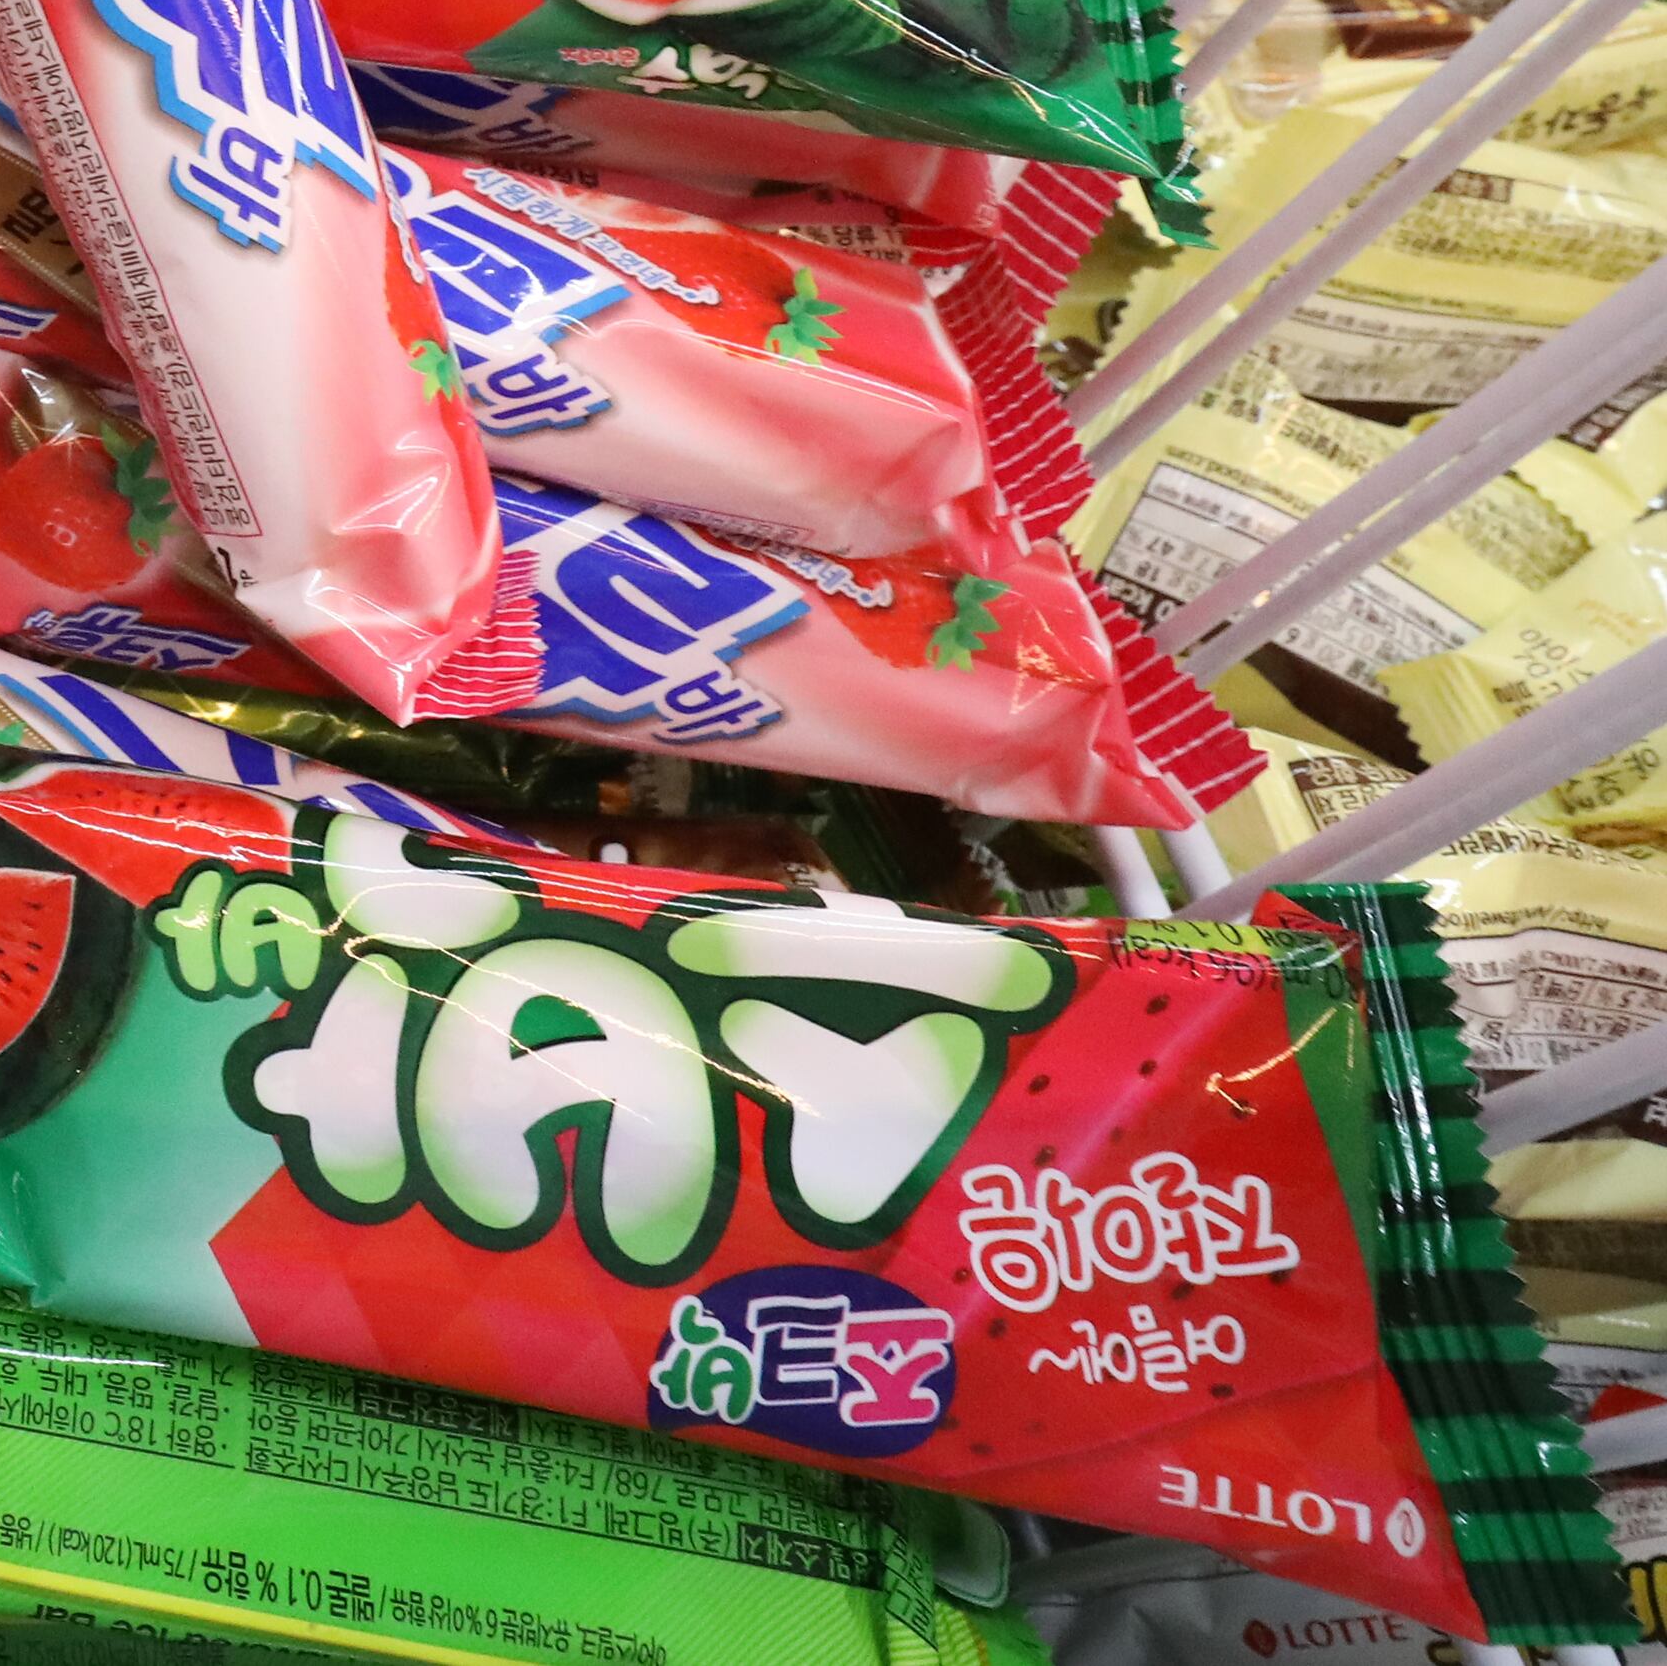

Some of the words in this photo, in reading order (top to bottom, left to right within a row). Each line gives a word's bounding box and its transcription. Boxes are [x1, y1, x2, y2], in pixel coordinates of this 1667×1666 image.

[958, 1149, 1301, 1317] 잘익은
[1158, 1464, 1374, 1538] LOTTE
[163, 1548, 186, 1580] 75
[201, 1548, 251, 1603] 함유
[254, 1561, 279, 1605] %
[285, 1567, 320, 1612] 0.1
[324, 1569, 376, 1624] 멜론
